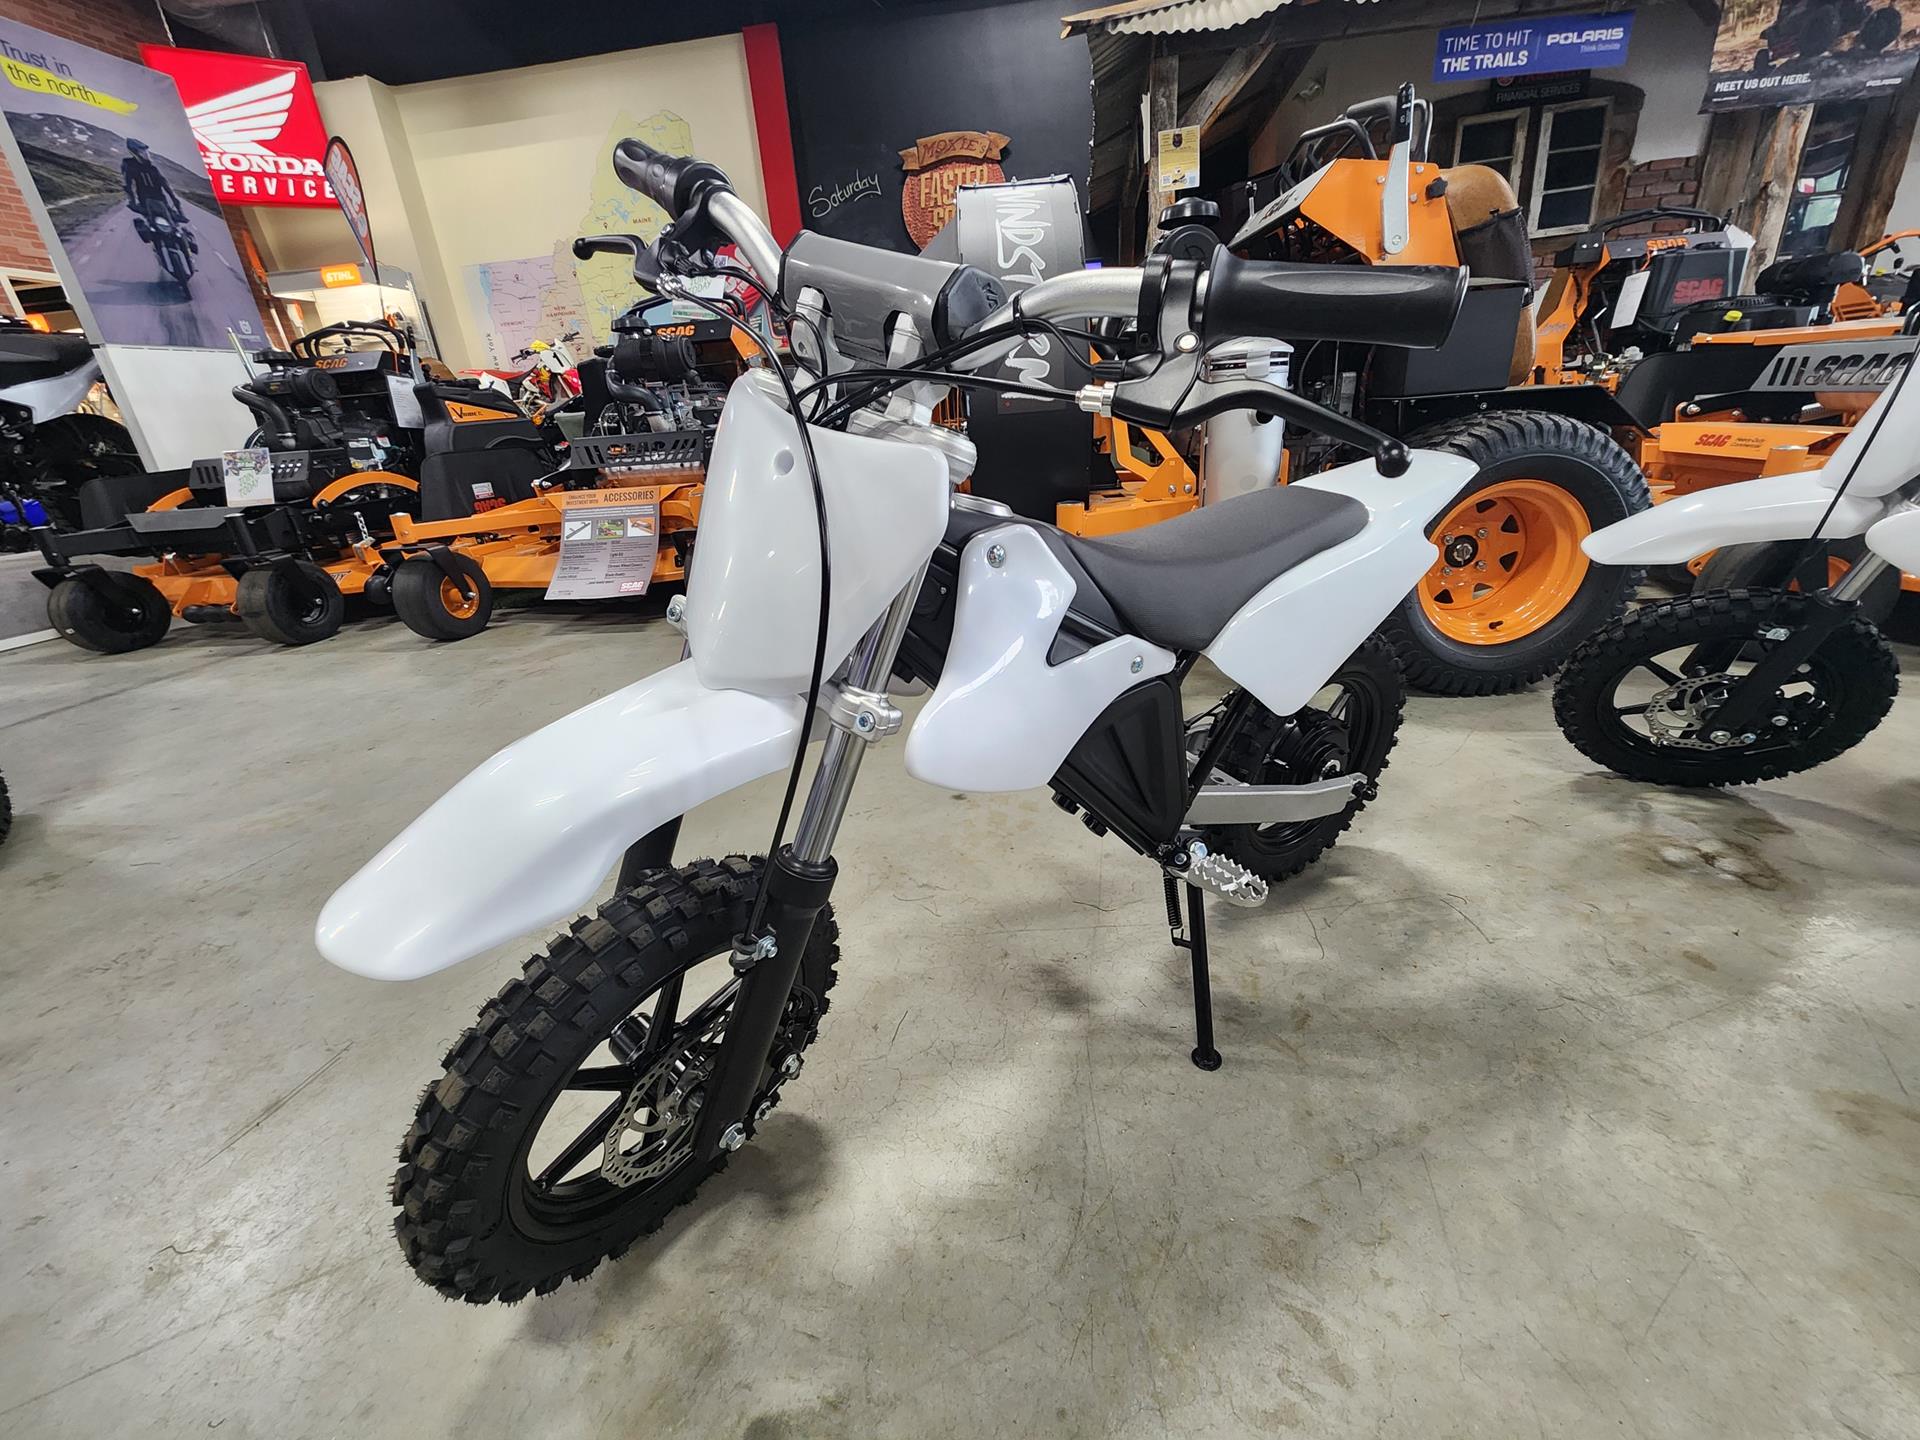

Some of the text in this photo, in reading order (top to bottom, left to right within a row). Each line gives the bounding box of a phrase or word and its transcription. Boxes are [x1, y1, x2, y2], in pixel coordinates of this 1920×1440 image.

[1445, 29, 1533, 54] TIME TO HIT
[1547, 27, 1624, 47] POLARIS
[0, 40, 72, 77] Trust in
[1442, 50, 1529, 73] THE TRAILS
[8, 63, 102, 105] the north.
[1714, 73, 1811, 93] MEET US OUT HERE.
[201, 151, 326, 177] HONDA
[209, 174, 336, 198] ERVICE
[808, 168, 882, 219] Saturday
[1647, 236, 1688, 251] SCAG
[326, 271, 355, 282] STIHL
[1674, 279, 1724, 297] SCAG
[656, 325, 696, 338] SCAG
[315, 358, 348, 369] SCAG
[552, 352, 565, 367] 1
[1804, 352, 1912, 386] SCAG
[1694, 433, 1732, 448] SCAG
[603, 490, 654, 503] ACCESSORIES
